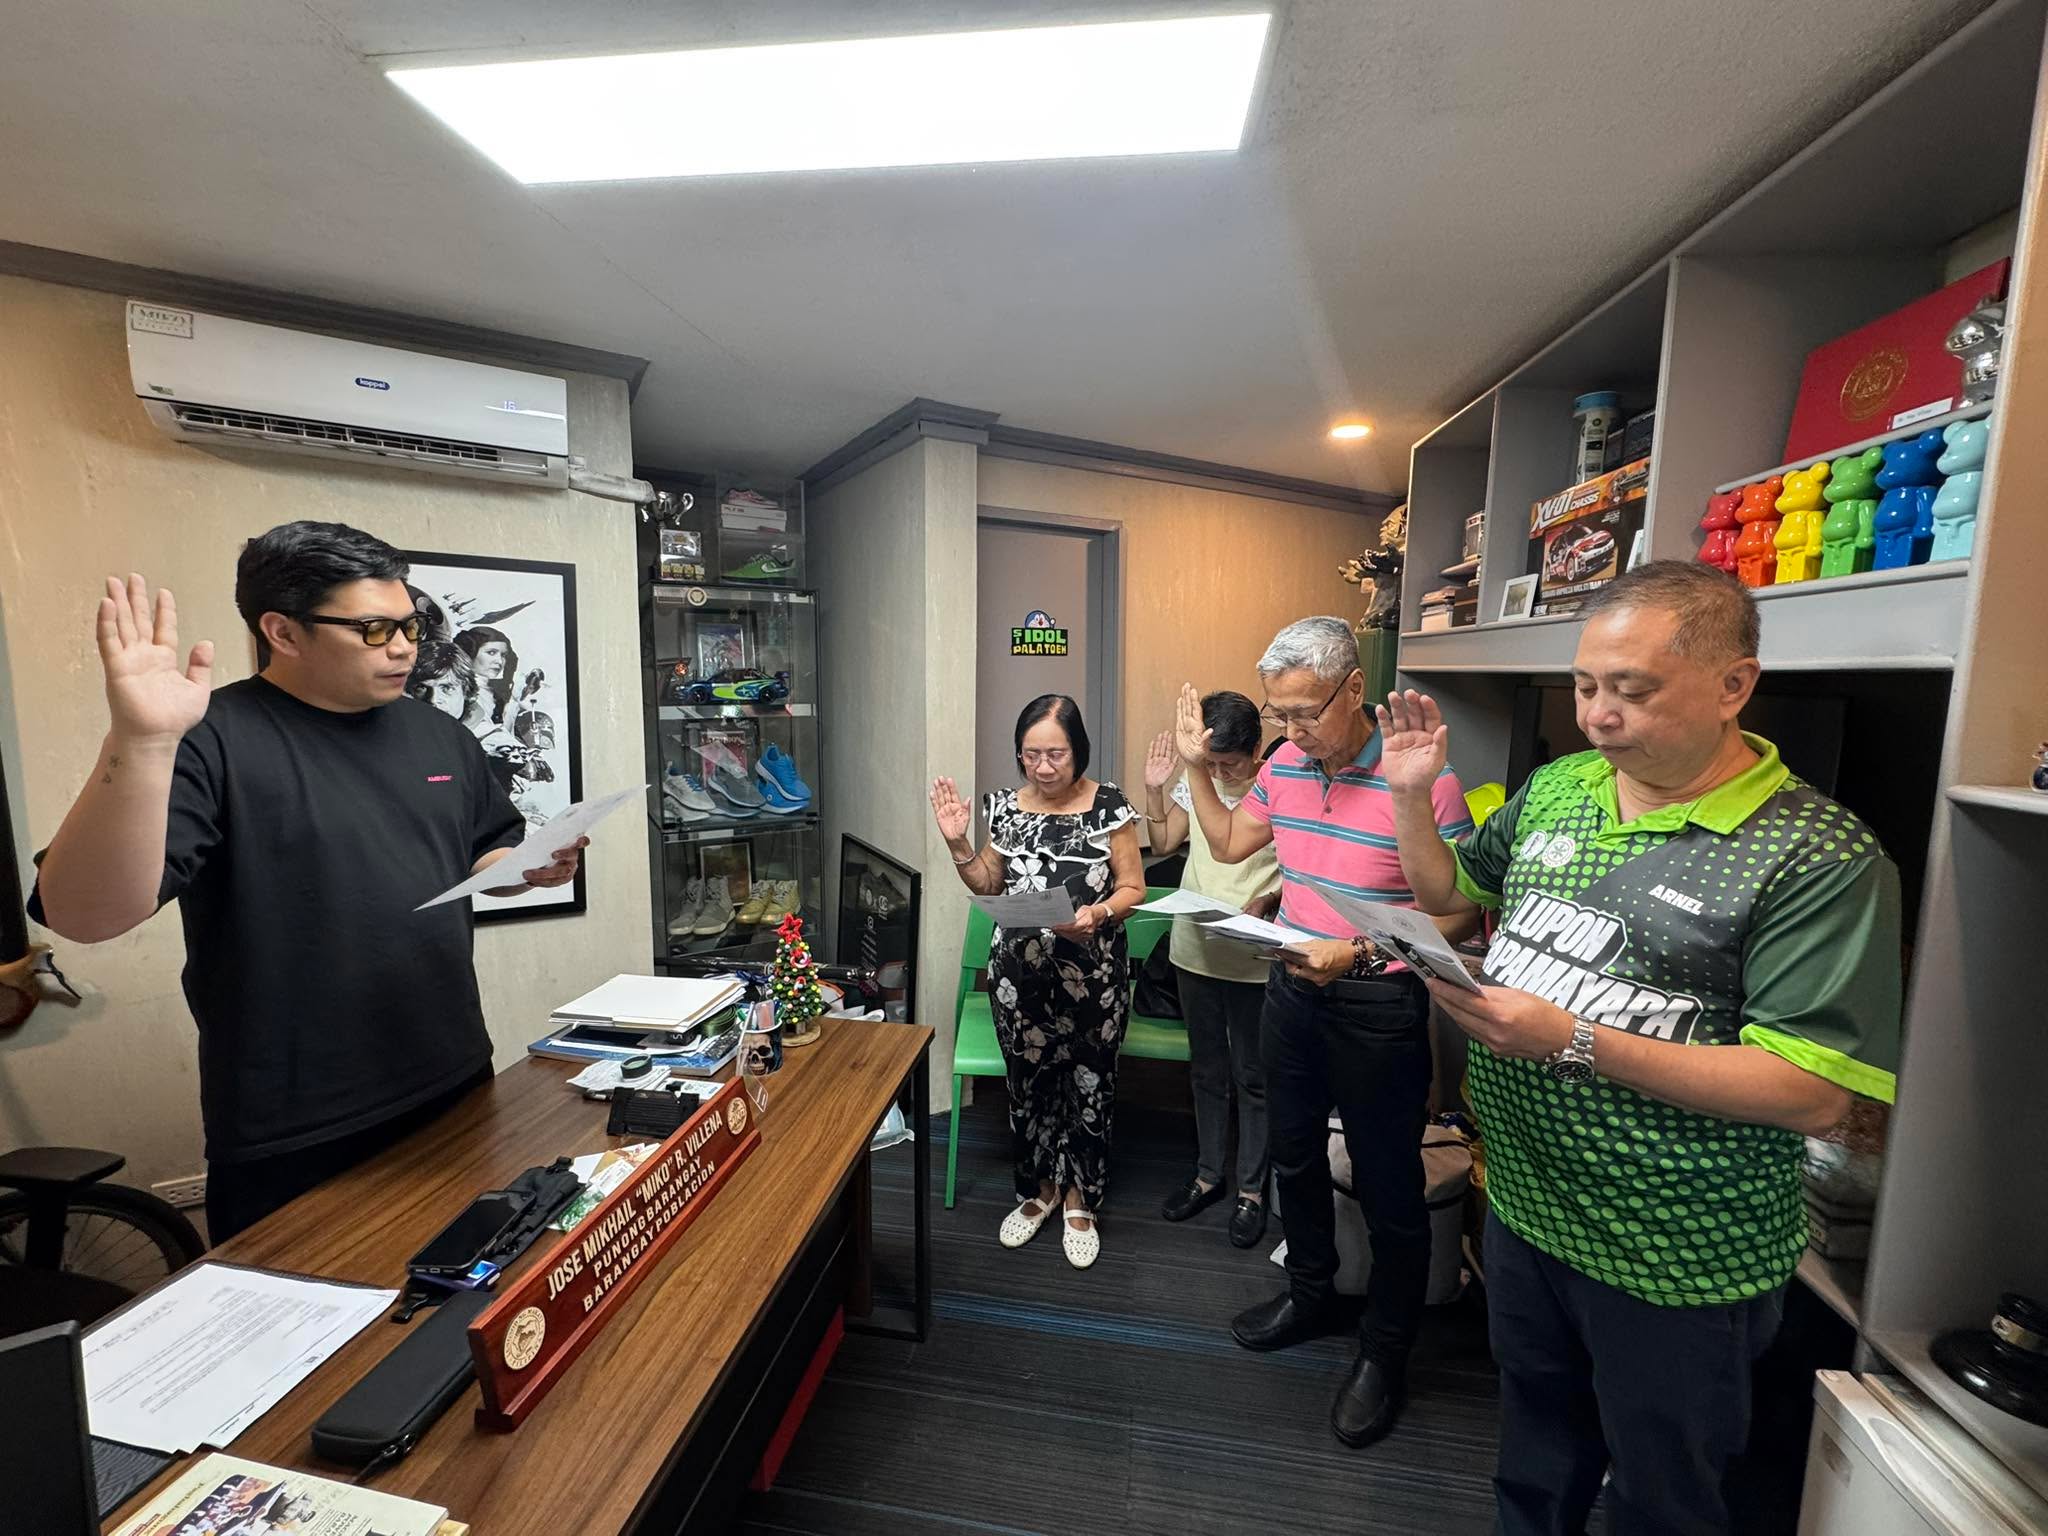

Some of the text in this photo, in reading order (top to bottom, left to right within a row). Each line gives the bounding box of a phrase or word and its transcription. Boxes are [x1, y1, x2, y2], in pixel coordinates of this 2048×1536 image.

[360, 378, 386, 389] koppel
[1570, 491, 1600, 511] CHASSIS
[1025, 629, 1066, 644] IDOL
[1648, 884, 1704, 916] ARNEL
[1507, 893, 1620, 963] LUPON
[546, 1249, 584, 1301] JOSE
[583, 1199, 637, 1263] MIKHAIL
[675, 1149, 687, 1170] R.
[685, 1110, 723, 1157] VILLENA
[593, 1215, 646, 1278] PUNONG
[646, 1156, 701, 1222] BARANGAY
[583, 1229, 655, 1312] BARANGAY
[655, 1161, 716, 1233] POBLACION
